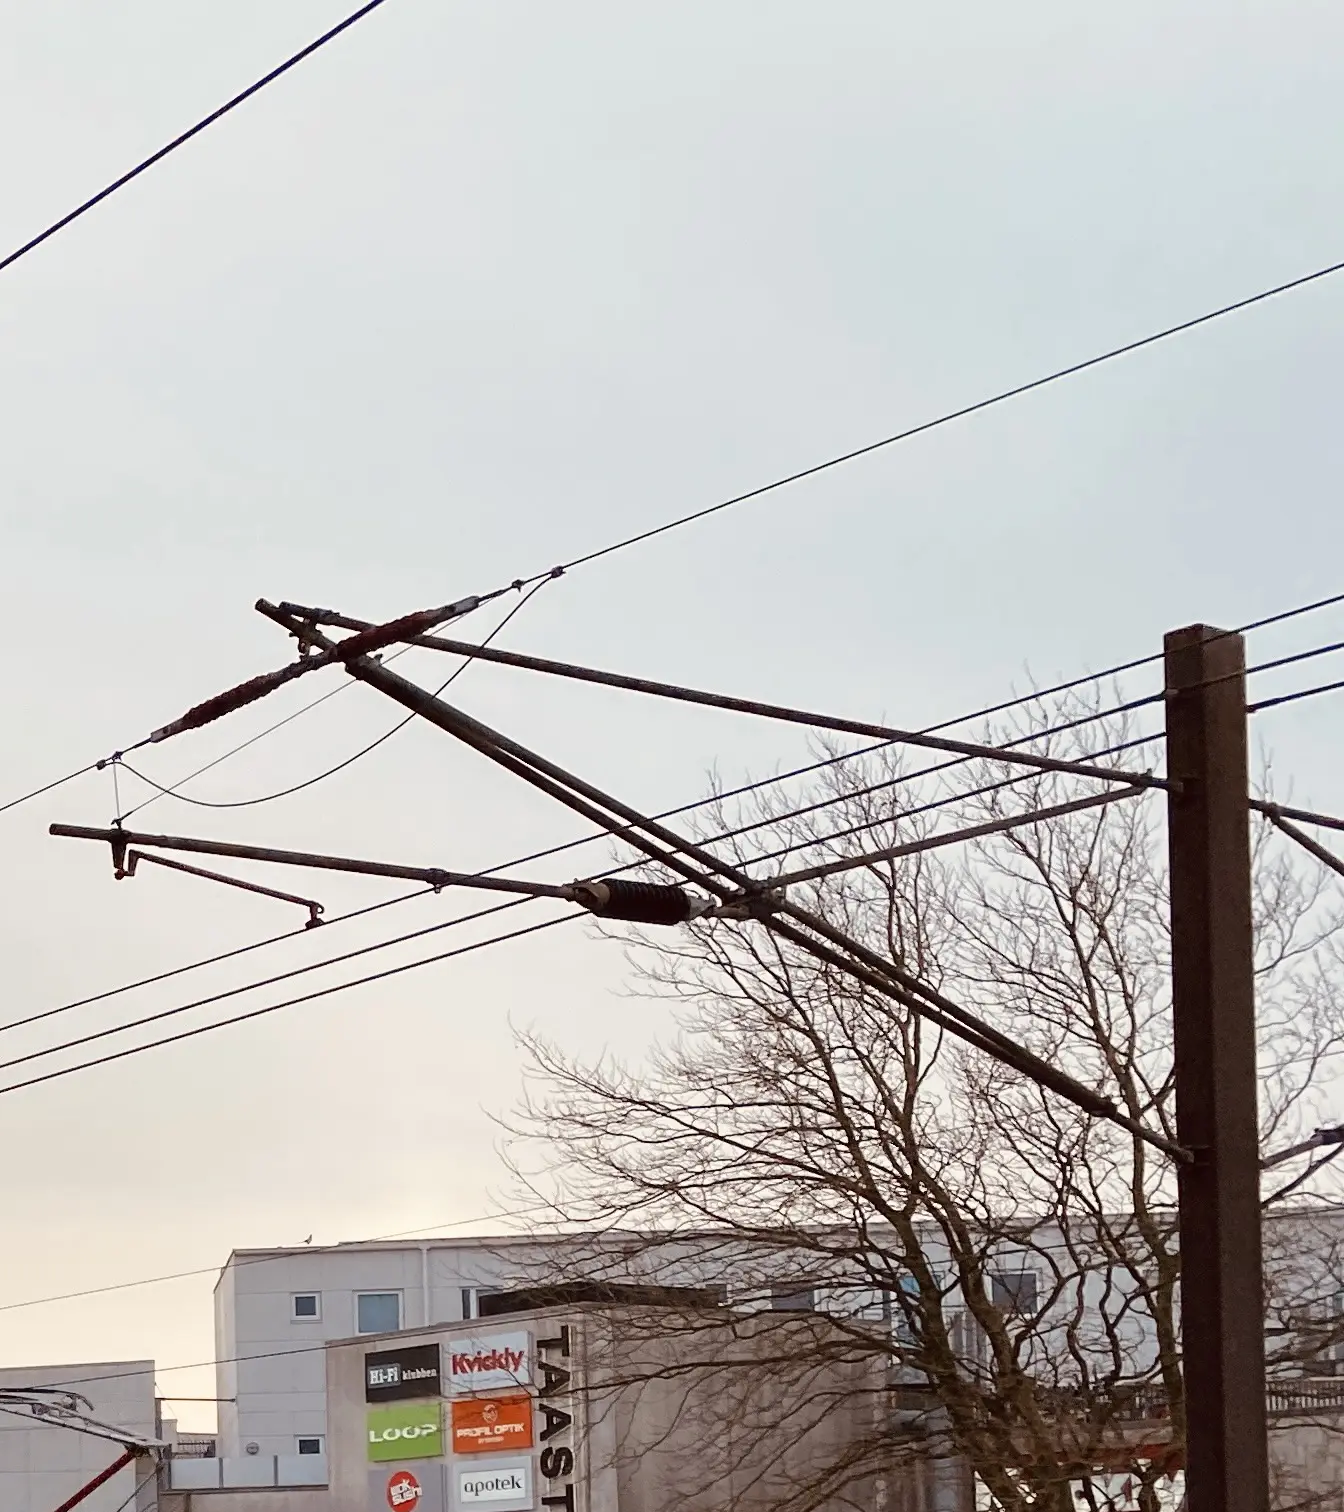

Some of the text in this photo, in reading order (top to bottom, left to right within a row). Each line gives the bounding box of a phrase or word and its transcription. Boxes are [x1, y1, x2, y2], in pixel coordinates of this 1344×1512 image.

[452, 1347, 524, 1375] Kvickly
[369, 1424, 437, 1443] LOOP
[456, 1423, 525, 1438] PROFIL OPTIK
[464, 1475, 523, 1496] apotek
